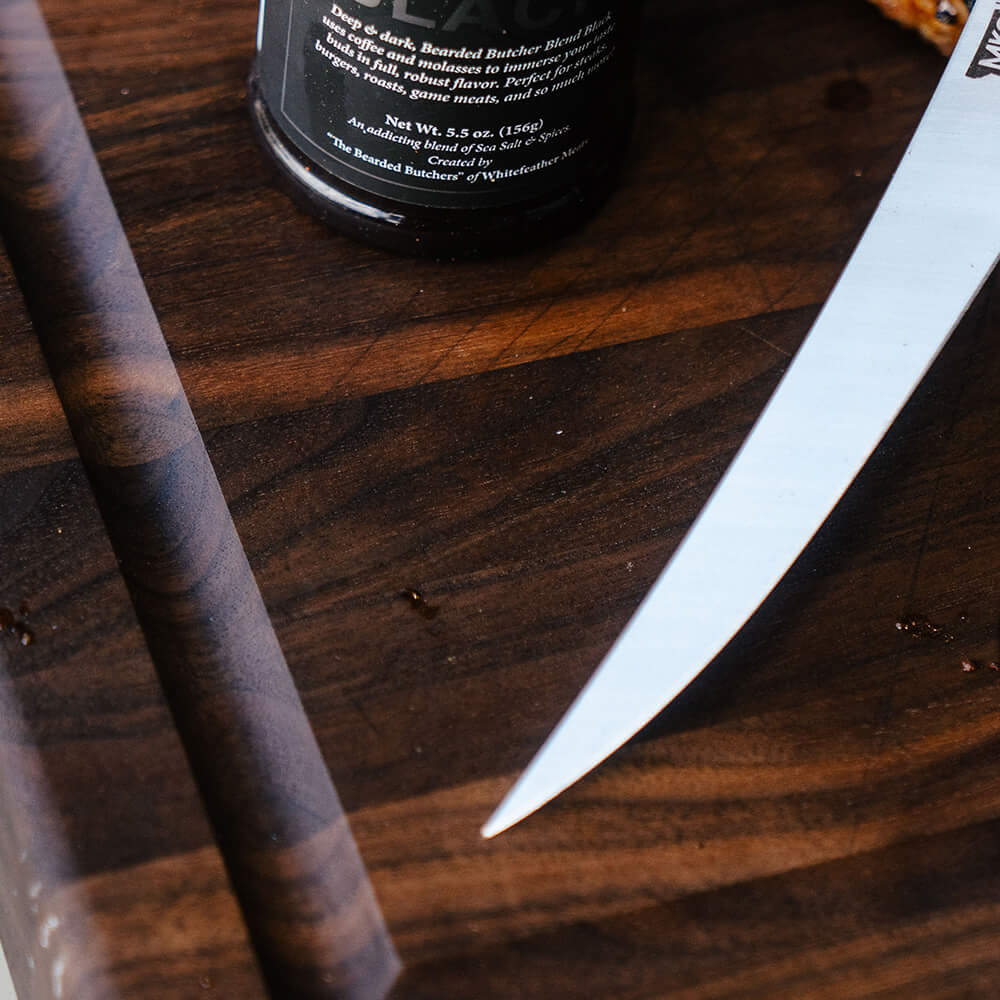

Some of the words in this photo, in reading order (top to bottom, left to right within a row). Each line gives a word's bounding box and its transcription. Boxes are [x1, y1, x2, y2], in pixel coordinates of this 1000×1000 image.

[322, 15, 346, 36] uses
[347, 33, 385, 55] coffee
[386, 50, 416, 66] and
[418, 58, 482, 75] molasses
[485, 60, 500, 75] to
[503, 53, 561, 74] immerse
[562, 40, 593, 64] your
[331, 3, 363, 31] Deep
[364, 24, 378, 35] &
[379, 31, 416, 52] dark,
[420, 41, 484, 60] Bearded
[485, 42, 542, 60] Butcher
[544, 27, 582, 52] Blend
[315, 40, 360, 77] burgers,
[363, 71, 407, 95] roasts,
[409, 88, 451, 104] game
[453, 91, 500, 105] meats,
[504, 86, 532, 102] and
[533, 86, 549, 98] so
[551, 70, 586, 93] much
[326, 32, 355, 57] buds
[357, 51, 371, 66] in
[370, 58, 400, 78] full,
[403, 70, 452, 87] robust
[449, 77, 499, 91] flavor.
[504, 68, 552, 89] Perfect
[551, 62, 574, 81] for
[347, 116, 366, 130] An
[366, 126, 422, 150] addicting
[424, 139, 459, 153] blend
[460, 142, 475, 155] of
[475, 143, 496, 153] Sea
[498, 138, 523, 151] Salt
[384, 113, 413, 131] Net
[415, 121, 442, 137] Wt.
[446, 127, 469, 139] 5.5
[472, 127, 494, 139] oz.
[499, 118, 545, 139] (156g)
[353, 147, 402, 173] Bearded
[466, 171, 482, 184] of
[481, 155, 560, 182] Whitefeather
[427, 155, 477, 168] Created
[477, 156, 493, 169] by
